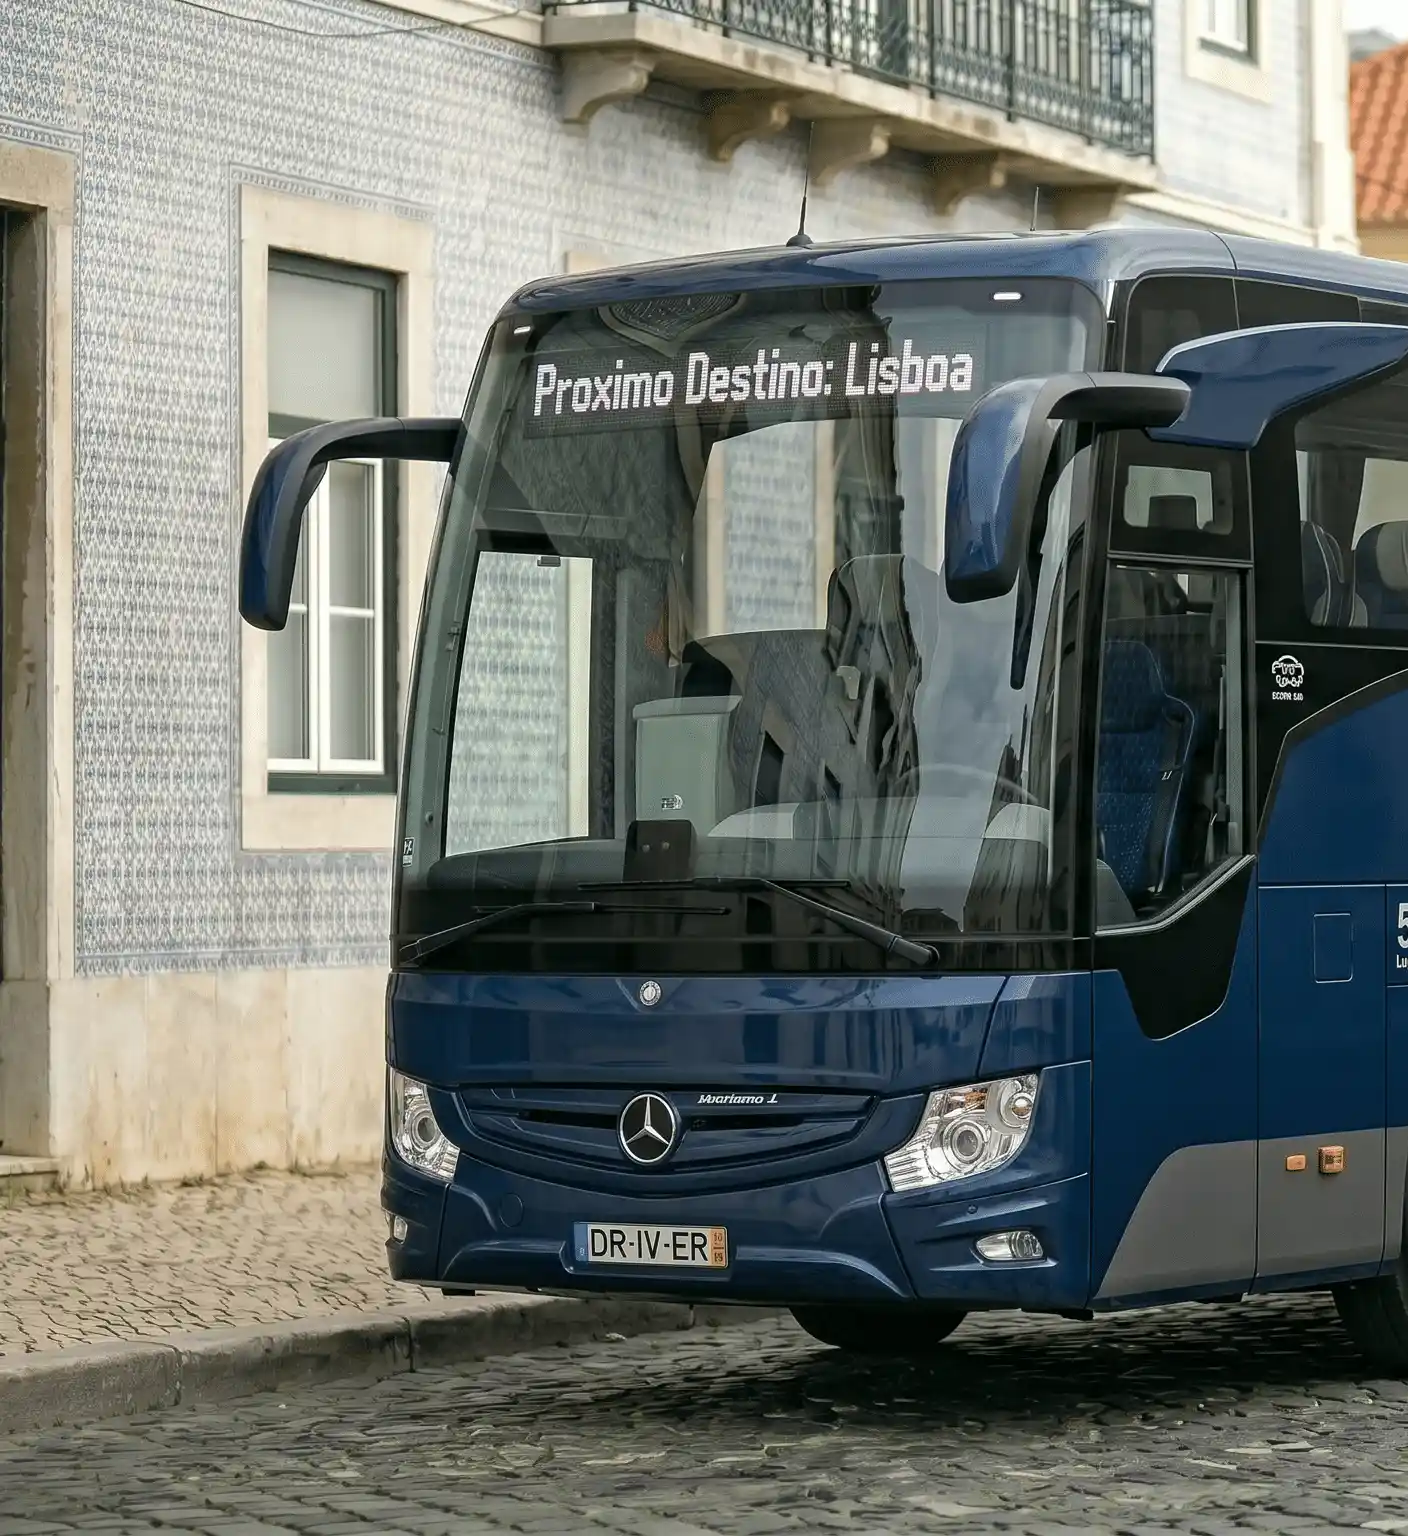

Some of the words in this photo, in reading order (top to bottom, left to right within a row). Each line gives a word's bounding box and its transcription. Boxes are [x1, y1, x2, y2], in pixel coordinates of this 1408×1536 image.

[533, 359, 673, 417] Proximo
[685, 348, 834, 405] Destino:
[845, 338, 974, 397] Lisboa
[590, 1228, 709, 1262] DR-IV-ER
